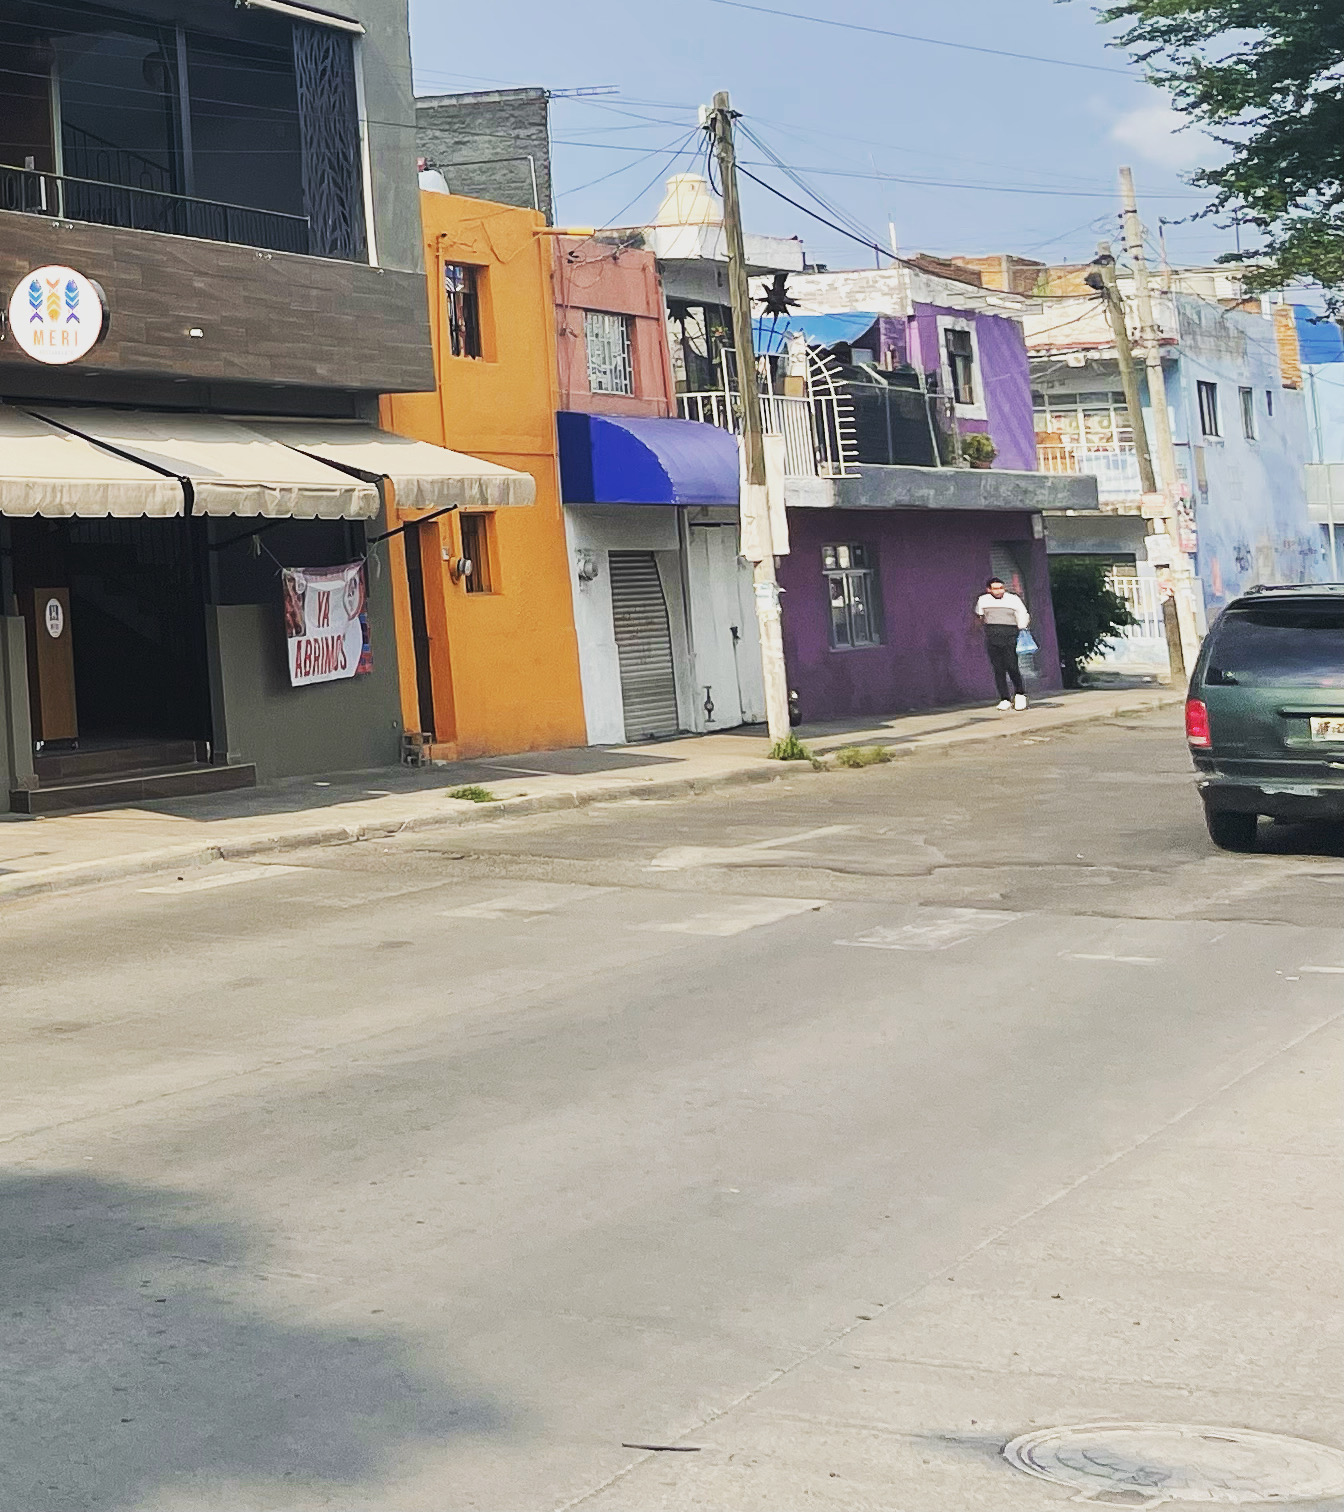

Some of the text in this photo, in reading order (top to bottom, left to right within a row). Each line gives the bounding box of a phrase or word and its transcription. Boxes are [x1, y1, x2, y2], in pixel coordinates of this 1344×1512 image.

[33, 329, 78, 347] MERI
[317, 590, 331, 628] YA
[294, 632, 347, 679] ABRIMOS
